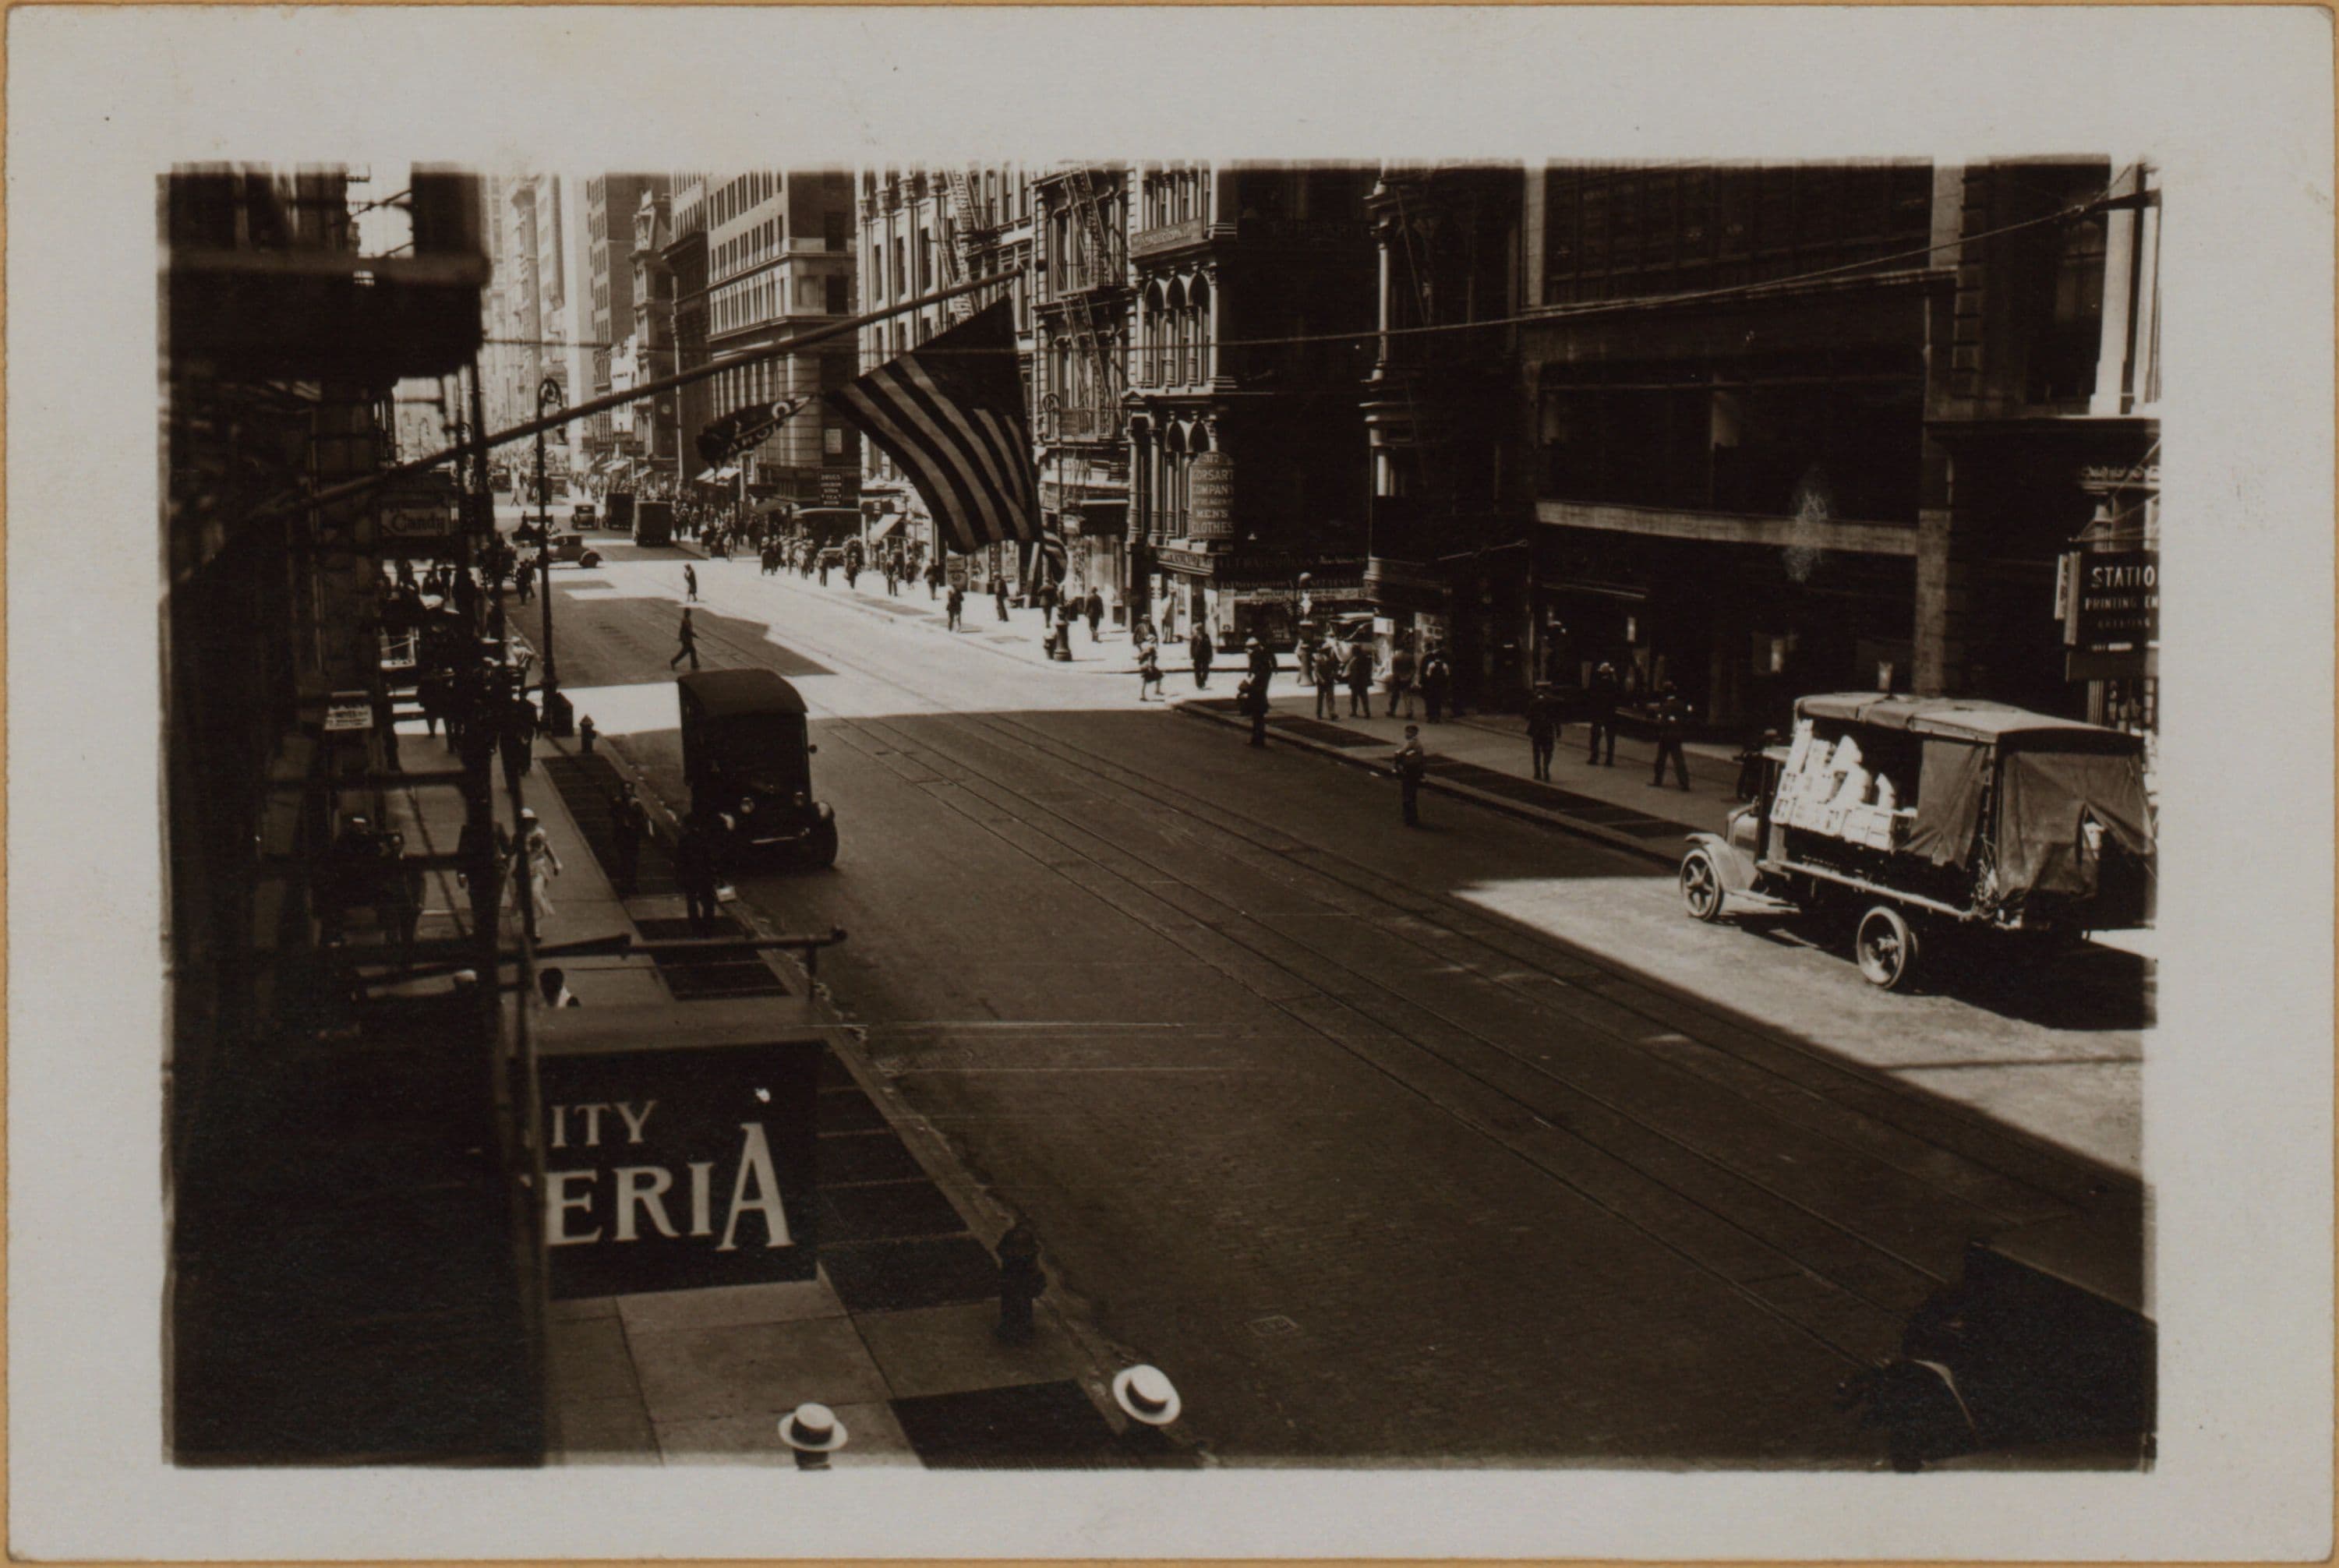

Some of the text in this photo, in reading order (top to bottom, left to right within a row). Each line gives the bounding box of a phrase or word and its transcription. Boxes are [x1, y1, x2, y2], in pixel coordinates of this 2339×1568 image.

[1192, 484, 1235, 495] COMPANY
[1192, 521, 1235, 535] CLOTHES
[523, 1098, 659, 1149] ITY
[519, 1121, 796, 1252] ERIA
